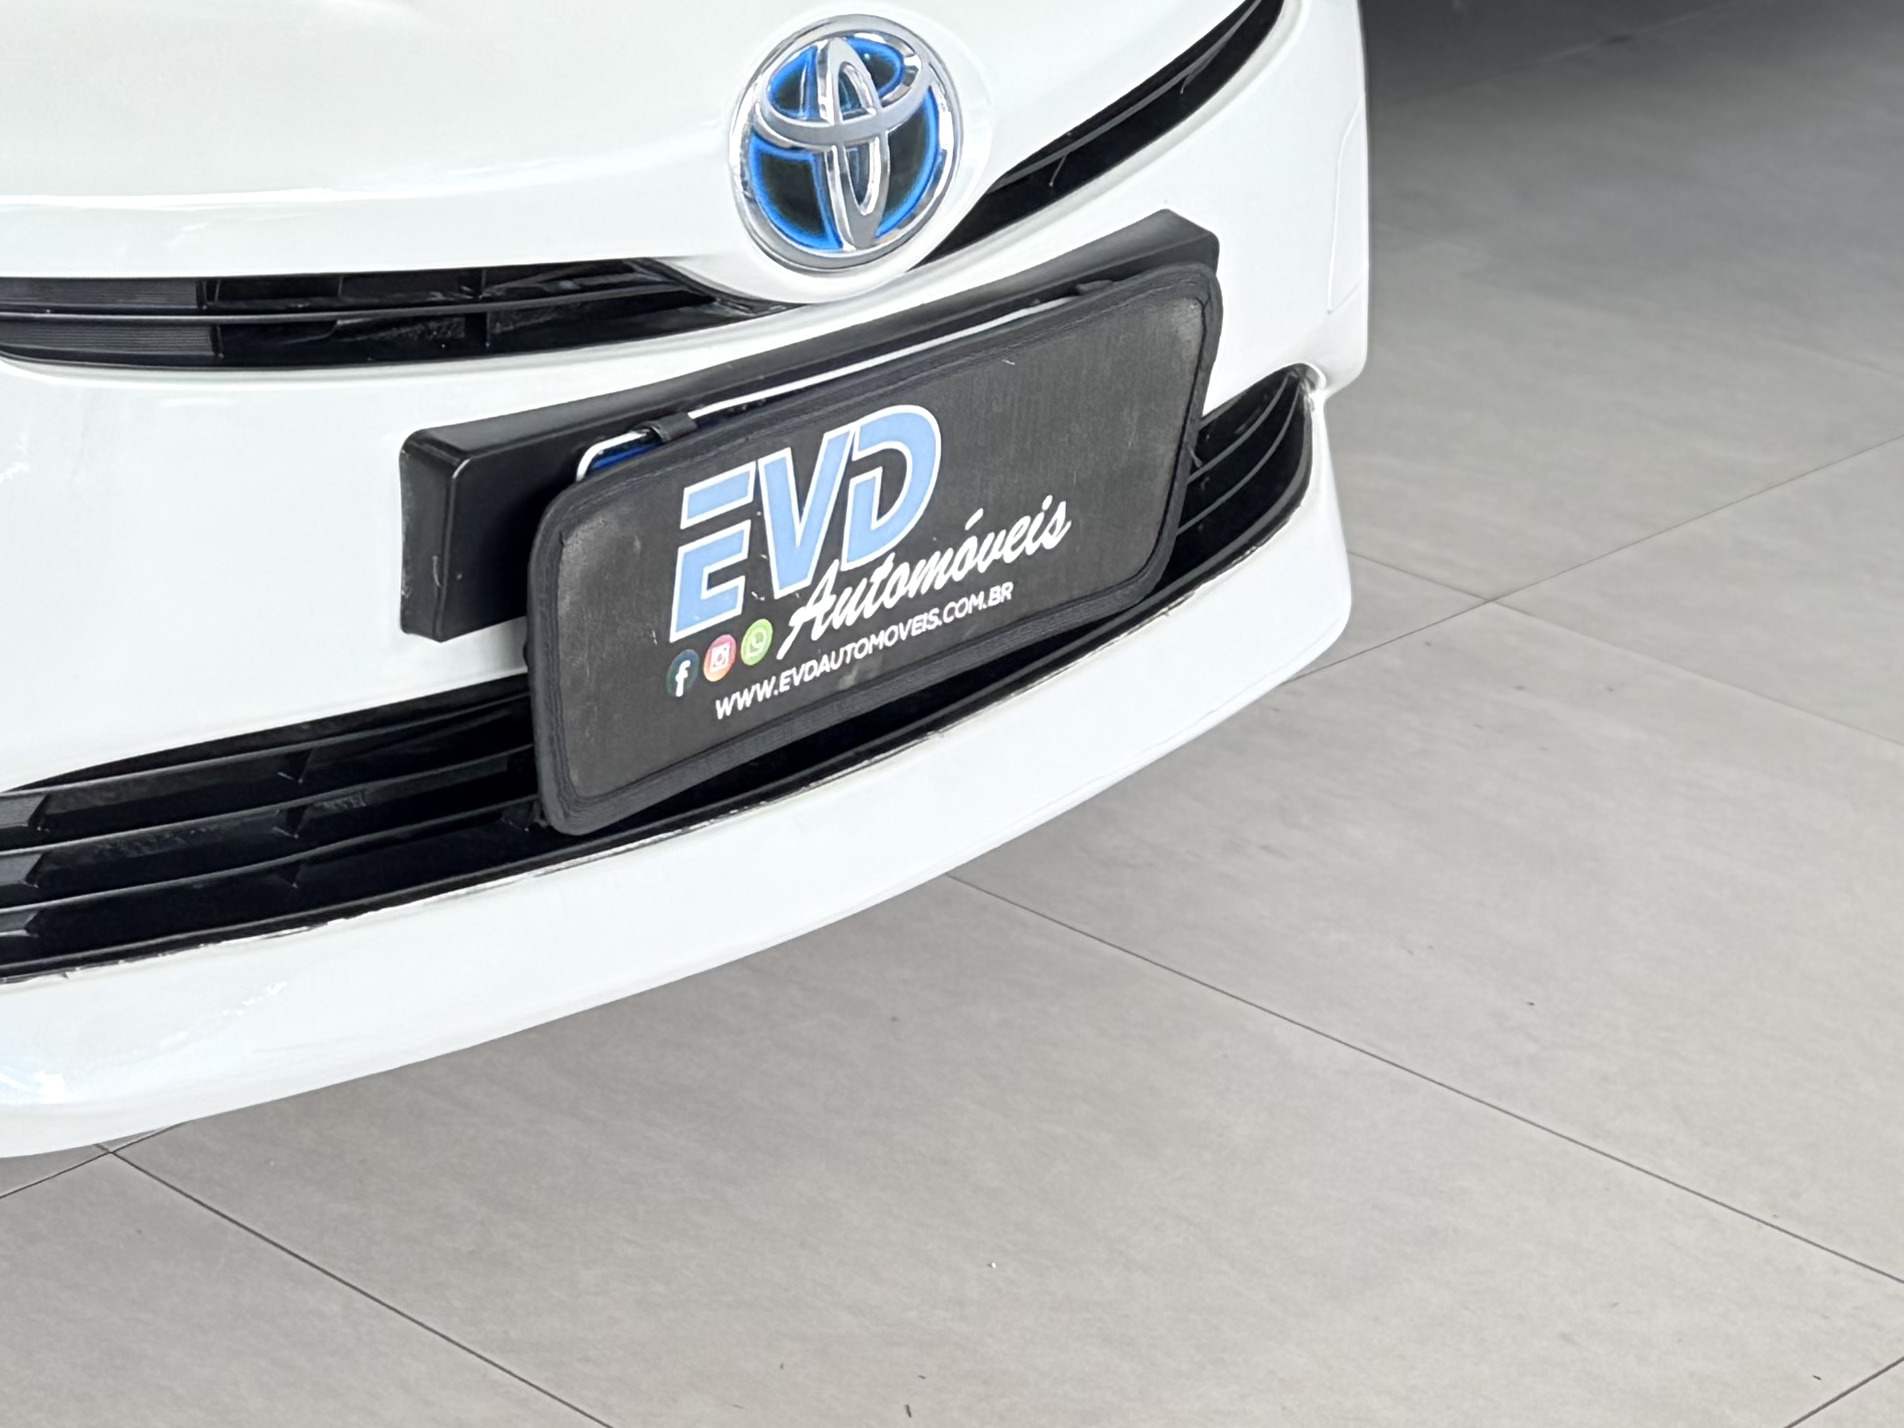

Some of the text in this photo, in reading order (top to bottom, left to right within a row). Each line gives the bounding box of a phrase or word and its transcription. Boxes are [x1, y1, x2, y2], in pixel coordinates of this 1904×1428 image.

[669, 404, 942, 642] EVD
[776, 494, 1072, 660] Automóveis
[714, 581, 1014, 720] WWW.EVDAUTOMOVEIS.COM.BR
